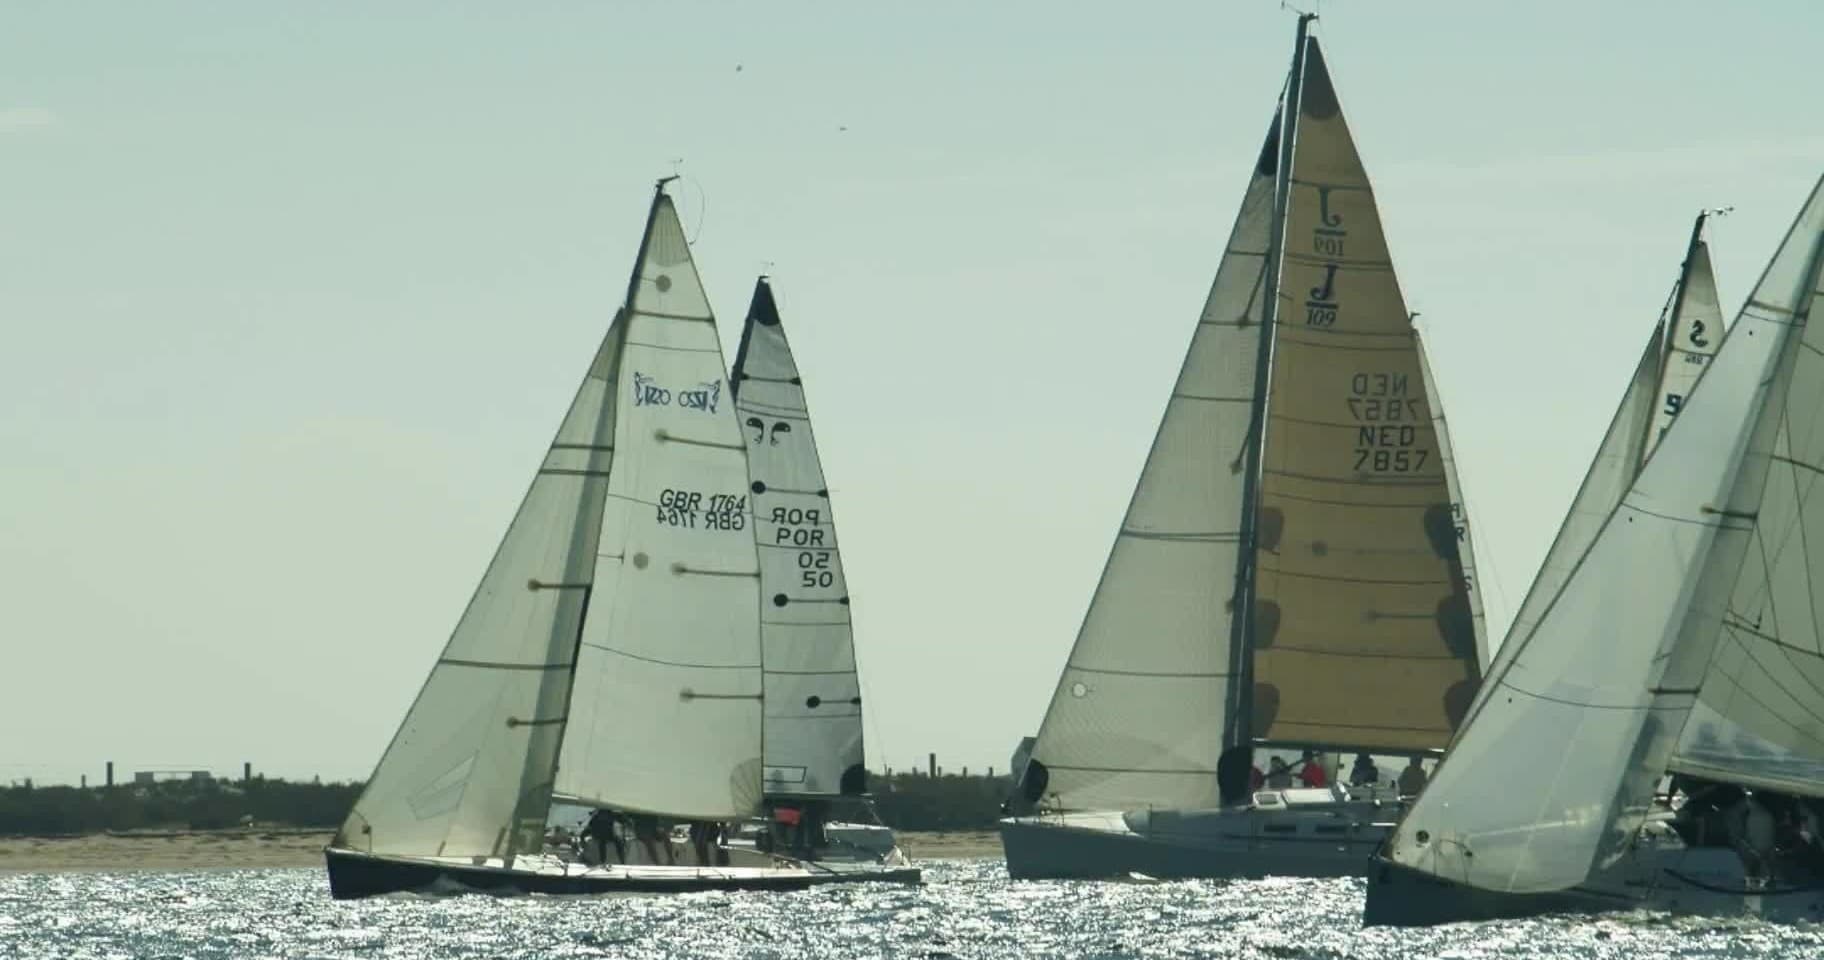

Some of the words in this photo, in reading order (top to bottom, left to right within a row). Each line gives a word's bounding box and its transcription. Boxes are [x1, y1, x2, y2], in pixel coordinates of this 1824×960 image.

[1310, 263, 1338, 300] J
[1307, 308, 1337, 326] 109
[1359, 425, 1415, 448] NED
[1353, 449, 1429, 472] 7857
[660, 489, 702, 509] GBR
[709, 494, 746, 511] 1764
[776, 528, 824, 546] POR
[802, 571, 833, 588] 50
